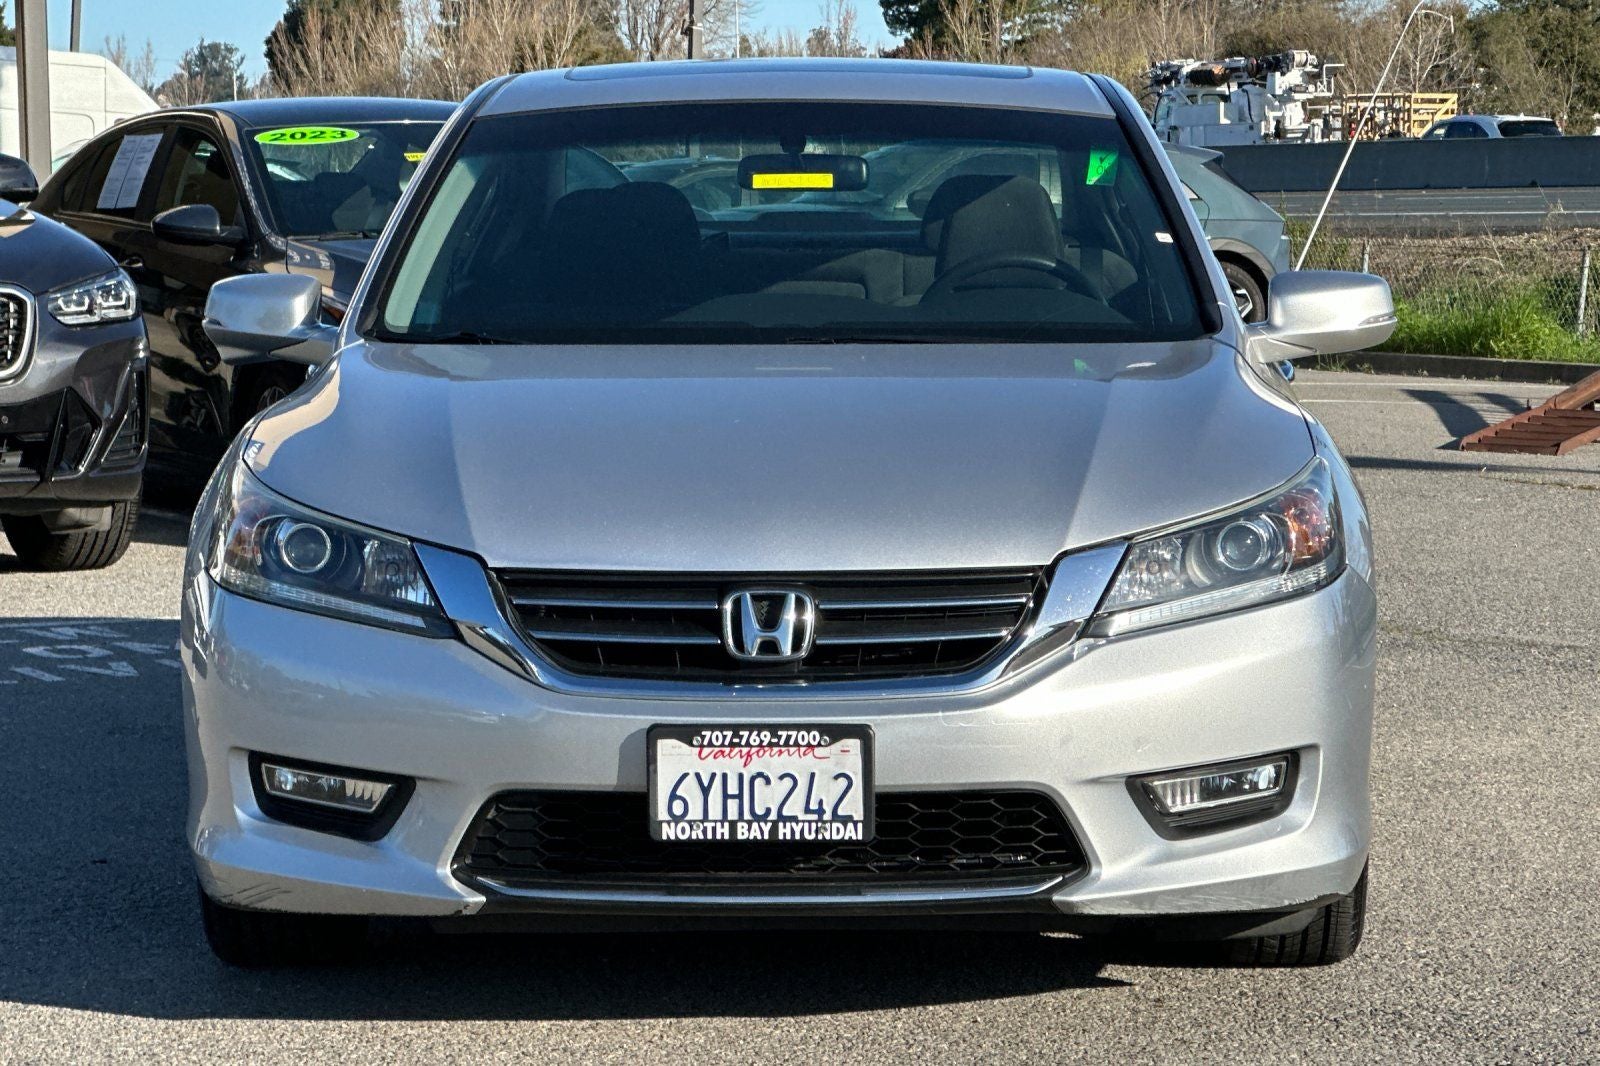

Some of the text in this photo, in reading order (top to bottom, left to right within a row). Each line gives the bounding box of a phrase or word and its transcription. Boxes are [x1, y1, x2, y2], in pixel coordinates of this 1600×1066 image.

[268, 130, 347, 142] 2023
[701, 731, 821, 746] 707-769-7700
[667, 771, 854, 822] 6YHC242
[661, 822, 863, 840] NORTH BAY HYUNDAI
